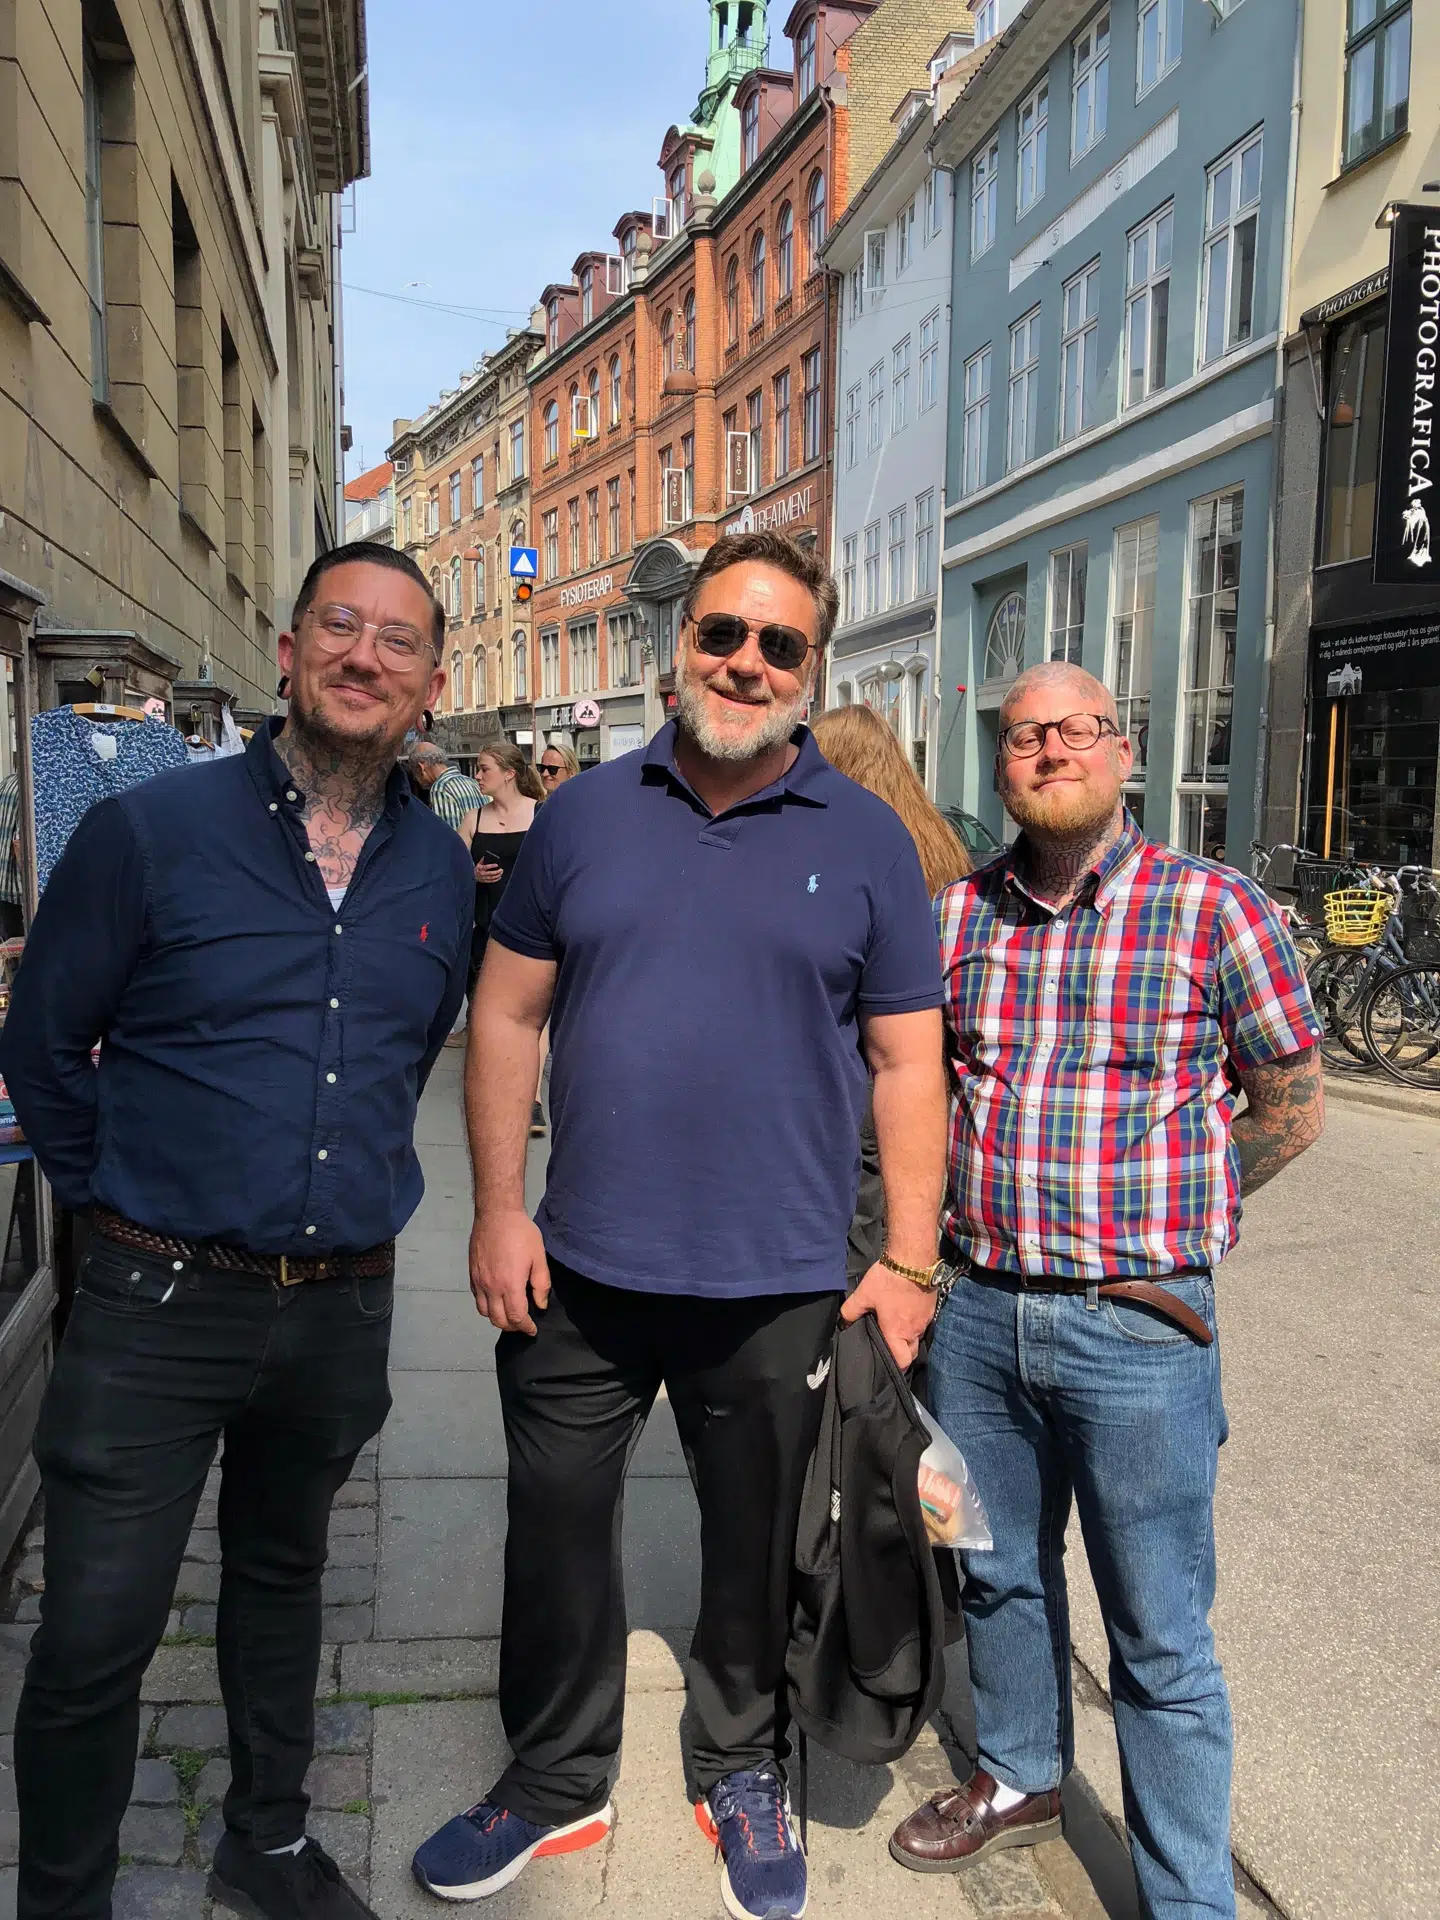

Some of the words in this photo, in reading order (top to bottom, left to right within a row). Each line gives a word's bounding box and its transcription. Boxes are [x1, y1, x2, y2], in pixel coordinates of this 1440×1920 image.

[1408, 226, 1440, 497] PHOTOGRAFICA
[560, 573, 613, 609] FYSIOTERAPI
[1348, 637, 1355, 645] du
[1410, 627, 1419, 636] hos
[1387, 642, 1394, 651] og
[1395, 640, 1407, 651] yder
